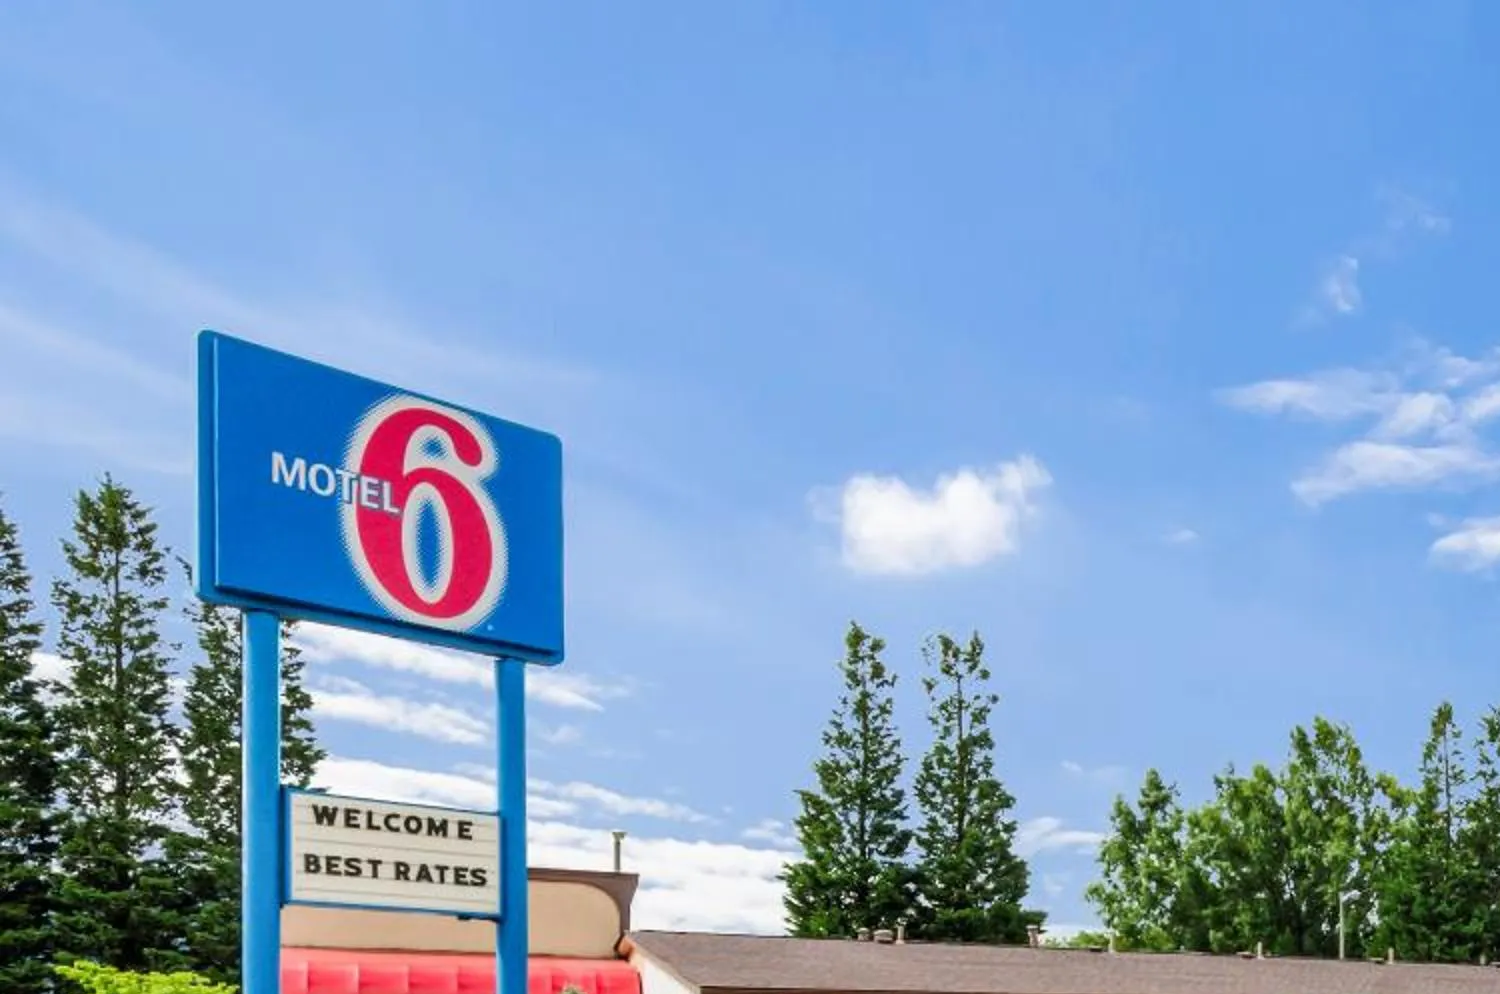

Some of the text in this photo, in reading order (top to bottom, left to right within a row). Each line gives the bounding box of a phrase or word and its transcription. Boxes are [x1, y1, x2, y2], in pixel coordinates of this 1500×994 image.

[270, 391, 509, 634] MOTEL 6
[311, 803, 474, 842] WELCOME
[303, 852, 488, 888] BEST RATES
